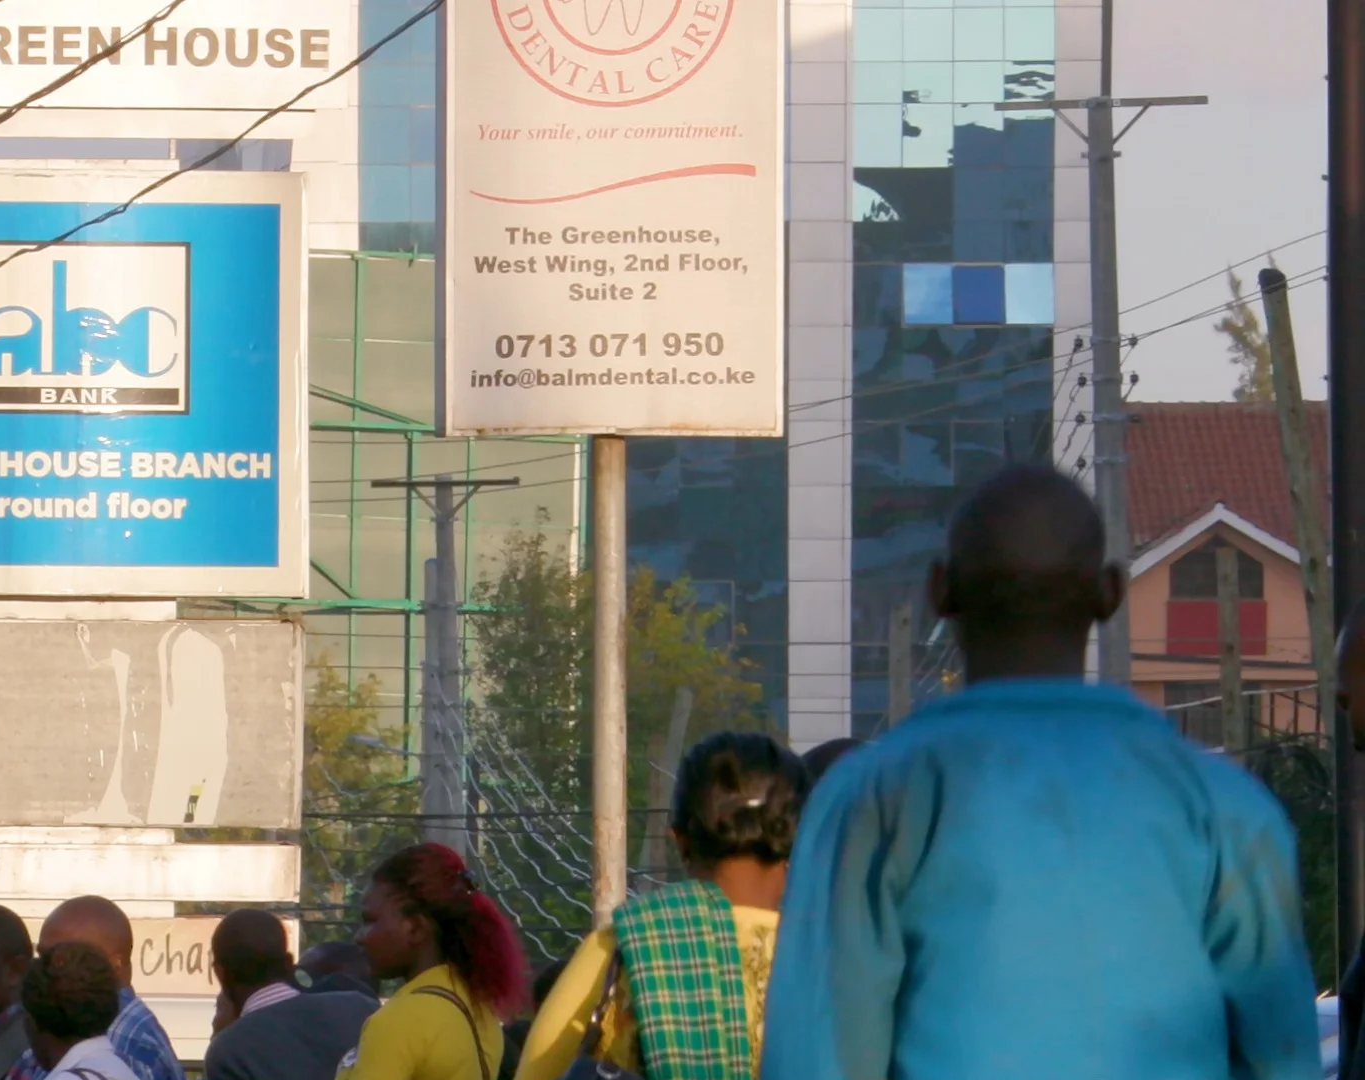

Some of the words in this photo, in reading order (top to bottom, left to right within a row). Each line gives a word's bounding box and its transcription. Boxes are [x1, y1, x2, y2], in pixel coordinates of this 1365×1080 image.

[144, 27, 330, 70] HOUSE
[507, 4, 635, 95] DENTAL
[645, 0, 719, 83] CARE
[478, 124, 521, 141] Your
[527, 123, 581, 142] smile,
[586, 126, 623, 140] our
[624, 122, 743, 140] commitment.
[505, 227, 552, 245] The
[561, 226, 720, 247] Greenhouse,
[474, 255, 537, 273] West
[545, 255, 615, 277] Wing,
[623, 253, 669, 272] 2nd
[678, 253, 748, 274] Floor,
[569, 282, 634, 301] Suite
[643, 281, 657, 300] 2
[495, 334, 577, 358] 0713
[589, 333, 649, 357] 071
[662, 332, 724, 356] 950
[470, 366, 755, 389] info@balmdental.co.ke
[40, 388, 118, 404] BANK
[131, 452, 271, 479] BRANCH
[107, 491, 187, 519] floor
